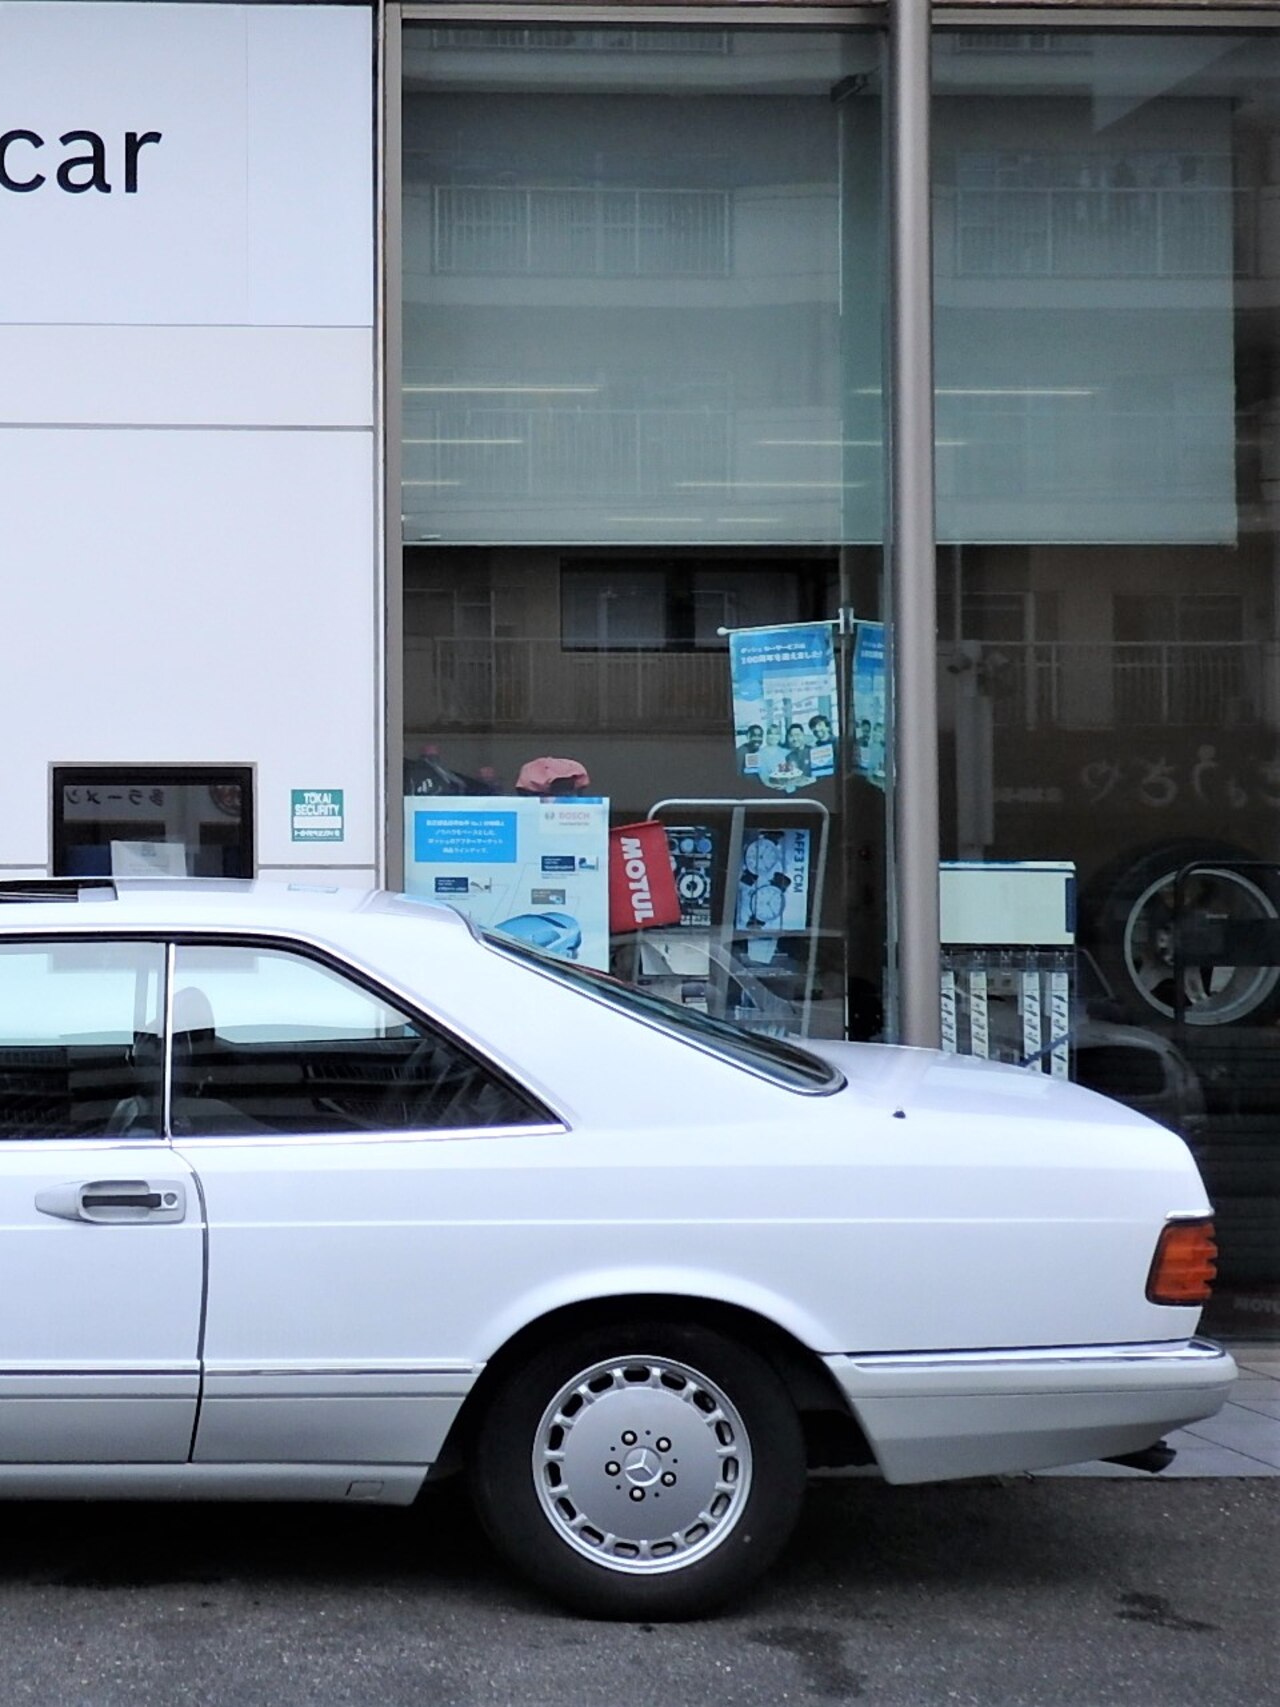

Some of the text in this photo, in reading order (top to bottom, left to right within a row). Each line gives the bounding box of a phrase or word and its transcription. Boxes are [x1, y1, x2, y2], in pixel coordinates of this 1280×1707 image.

[303, 792, 332, 804] TOKAI
[295, 804, 339, 816] SECURITY
[620, 837, 655, 924] MOTUL
[793, 866, 804, 893] TCM
